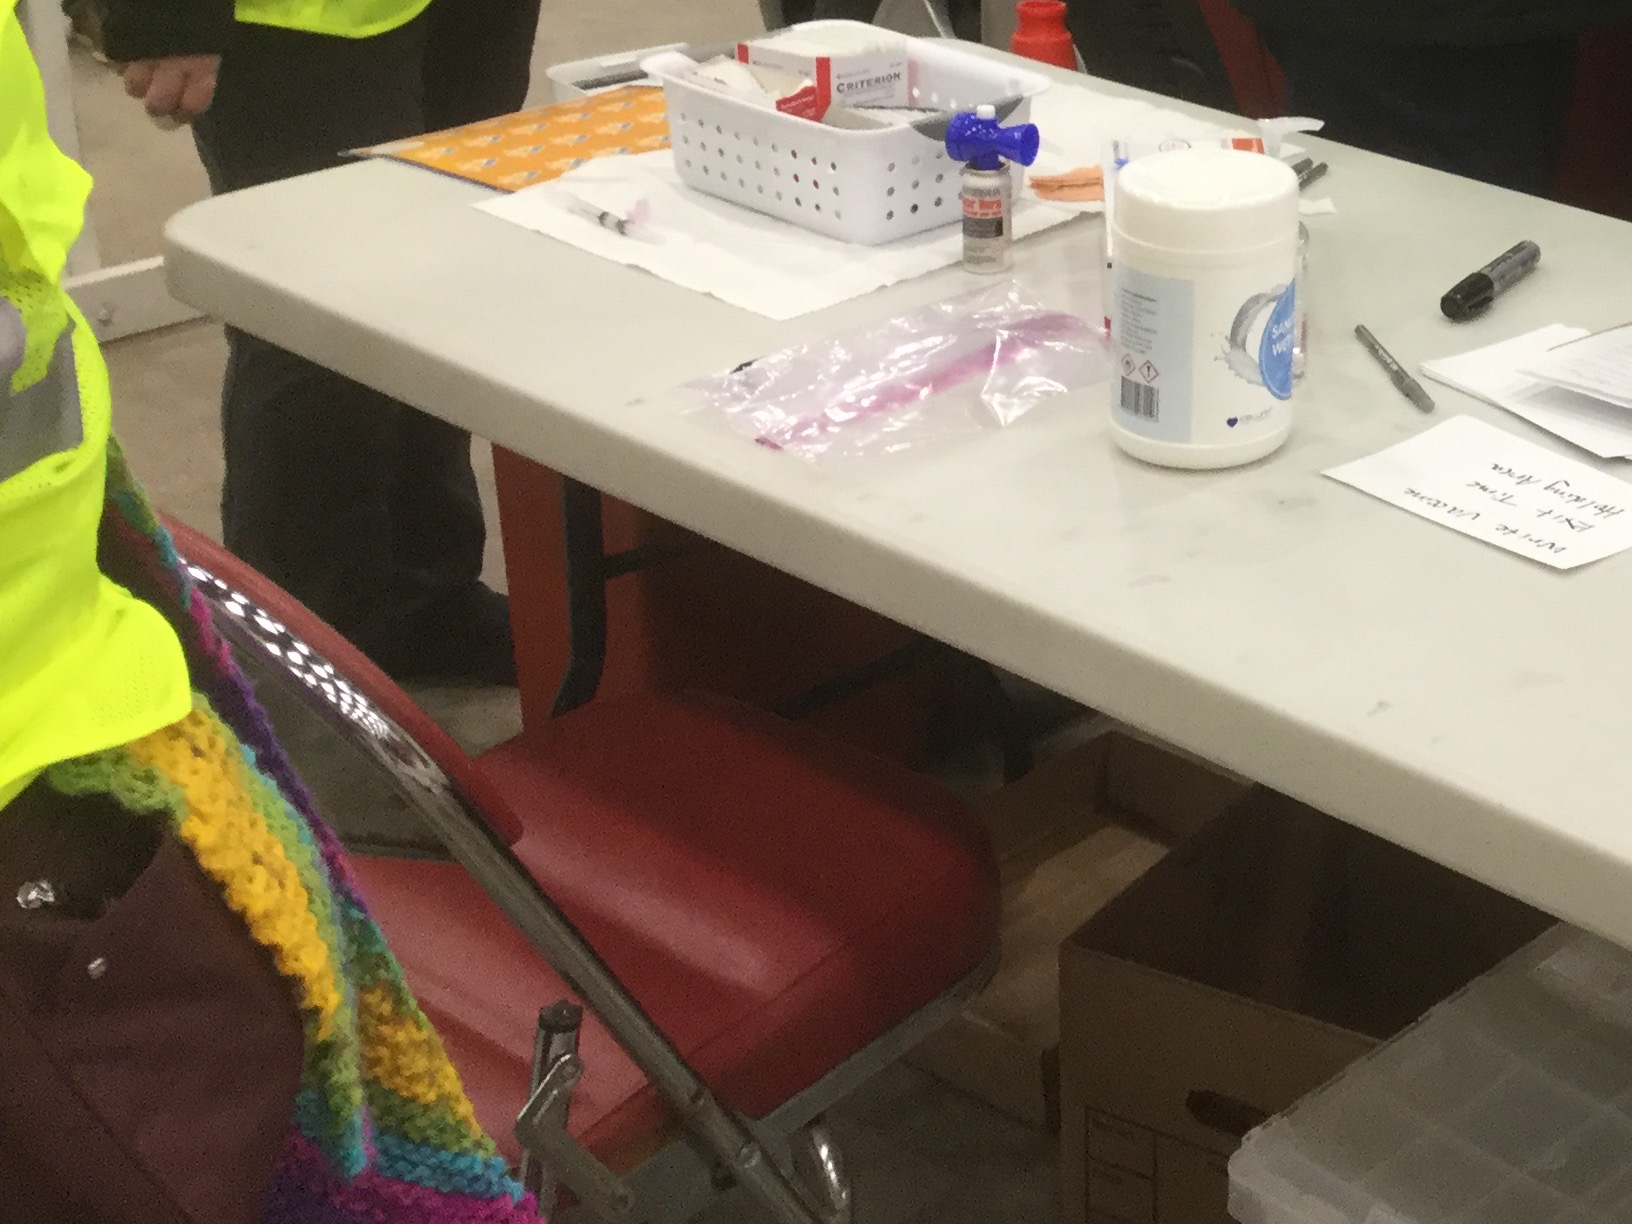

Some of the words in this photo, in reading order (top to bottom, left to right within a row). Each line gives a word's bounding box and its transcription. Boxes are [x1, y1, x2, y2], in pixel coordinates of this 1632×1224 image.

[836, 72, 901, 95] CRITERION
[1536, 508, 1595, 533] Exit
[1495, 523, 1567, 554] Write
